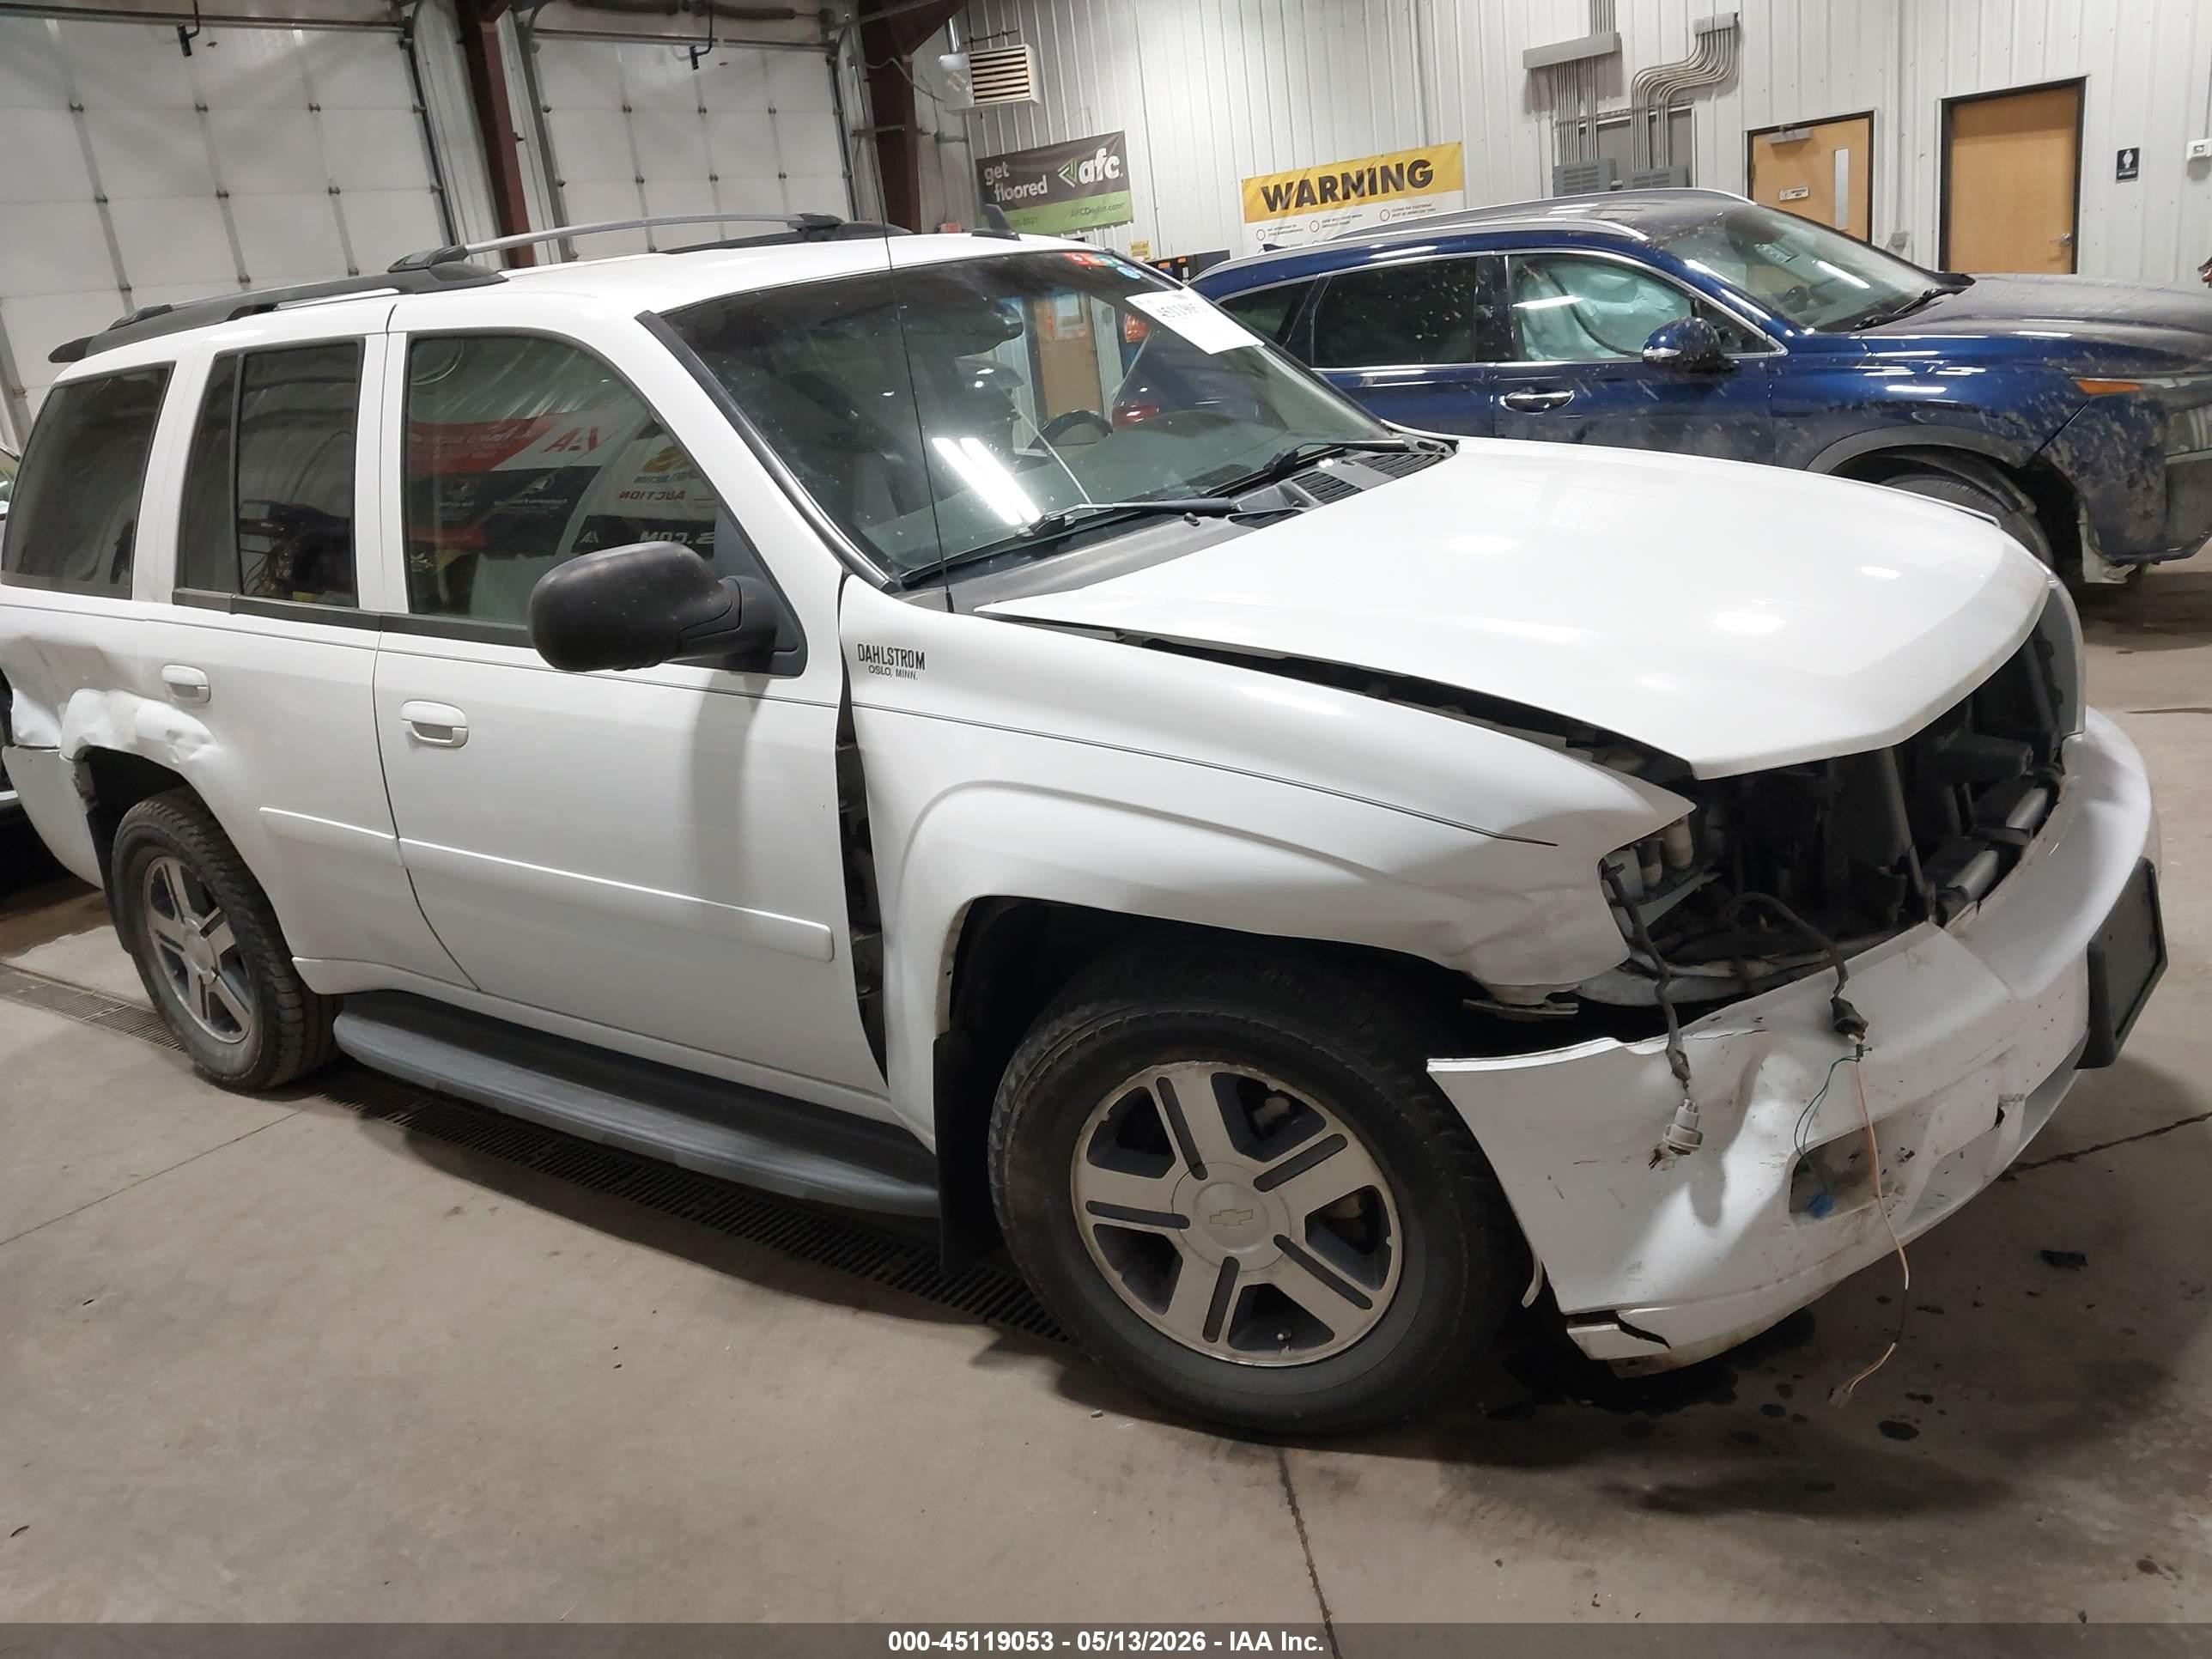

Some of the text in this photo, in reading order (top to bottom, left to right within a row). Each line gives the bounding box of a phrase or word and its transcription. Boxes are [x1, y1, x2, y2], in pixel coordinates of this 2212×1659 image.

[984, 161, 1010, 185] get
[1261, 159, 1434, 213] WARNING
[994, 174, 1048, 202] floored
[857, 643, 926, 671] DAHLSTROM
[868, 665, 893, 678] OSLO,
